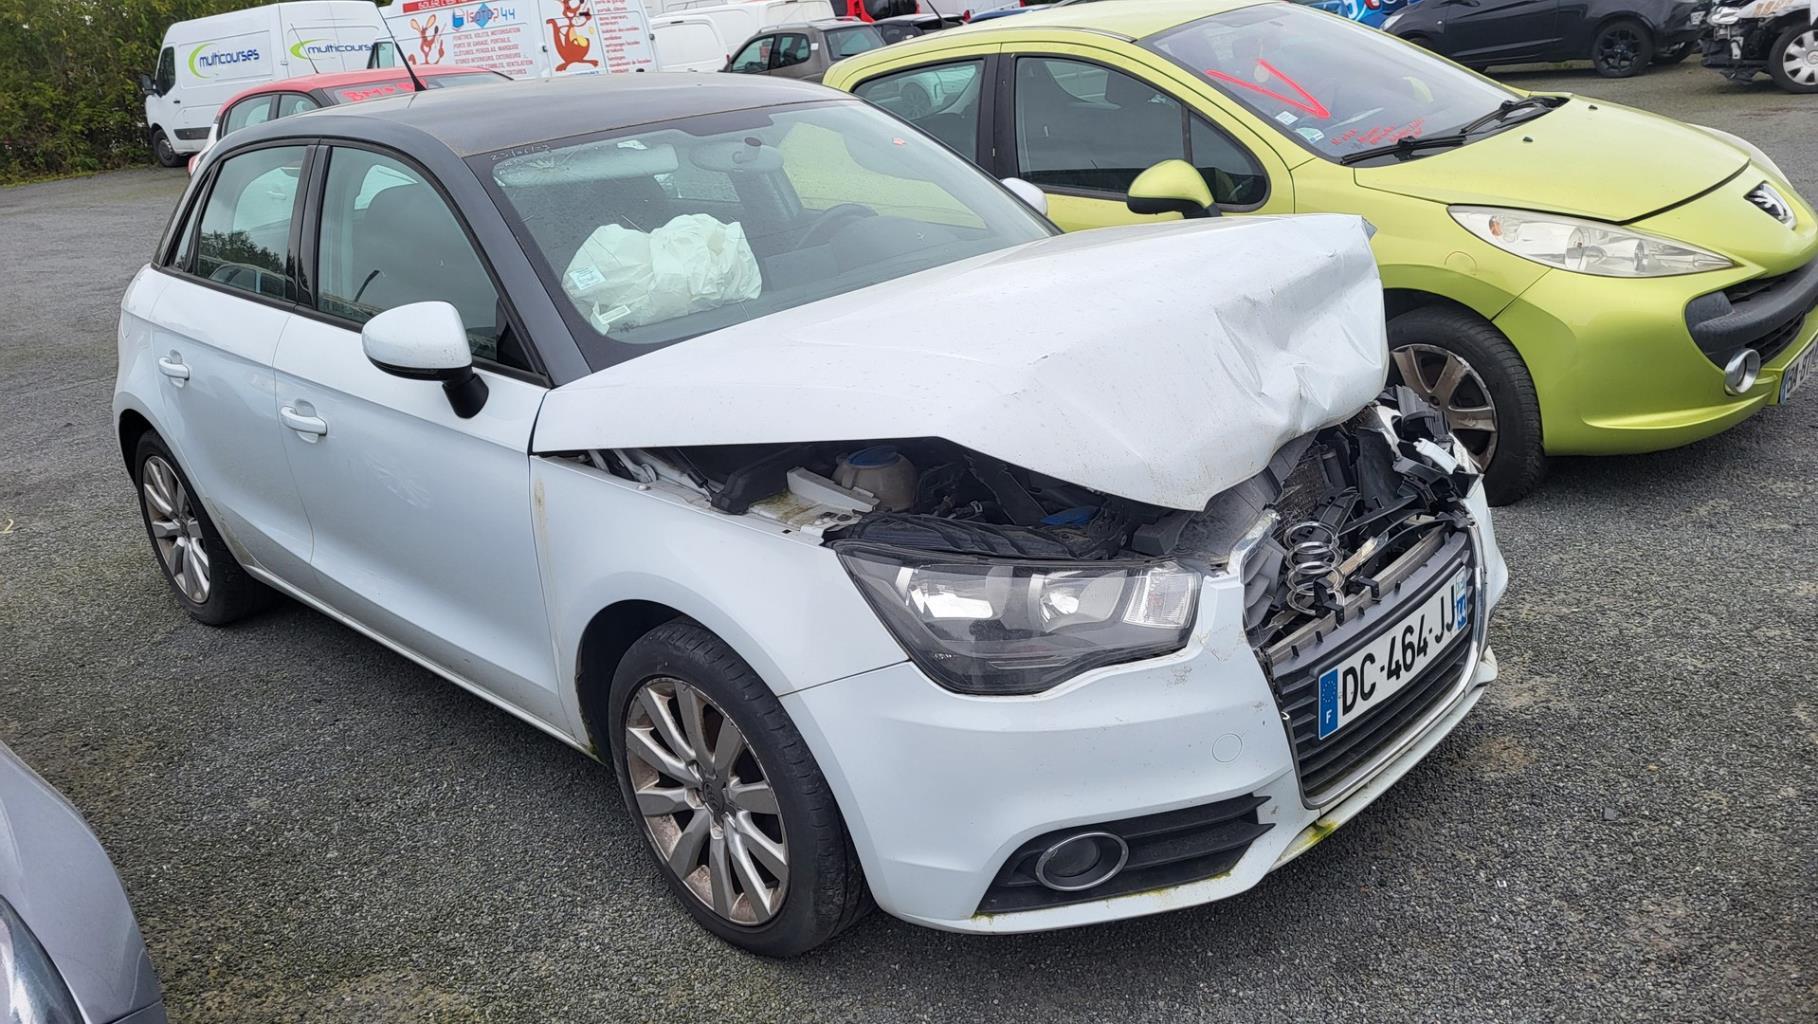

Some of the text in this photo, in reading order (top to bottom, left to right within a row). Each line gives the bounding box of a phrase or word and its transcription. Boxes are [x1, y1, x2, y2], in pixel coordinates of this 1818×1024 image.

[500, 6, 516, 21] 44
[199, 48, 260, 68] multicourses
[1342, 585, 1455, 717] DC-464-JJ
[1325, 709, 1333, 725] F
